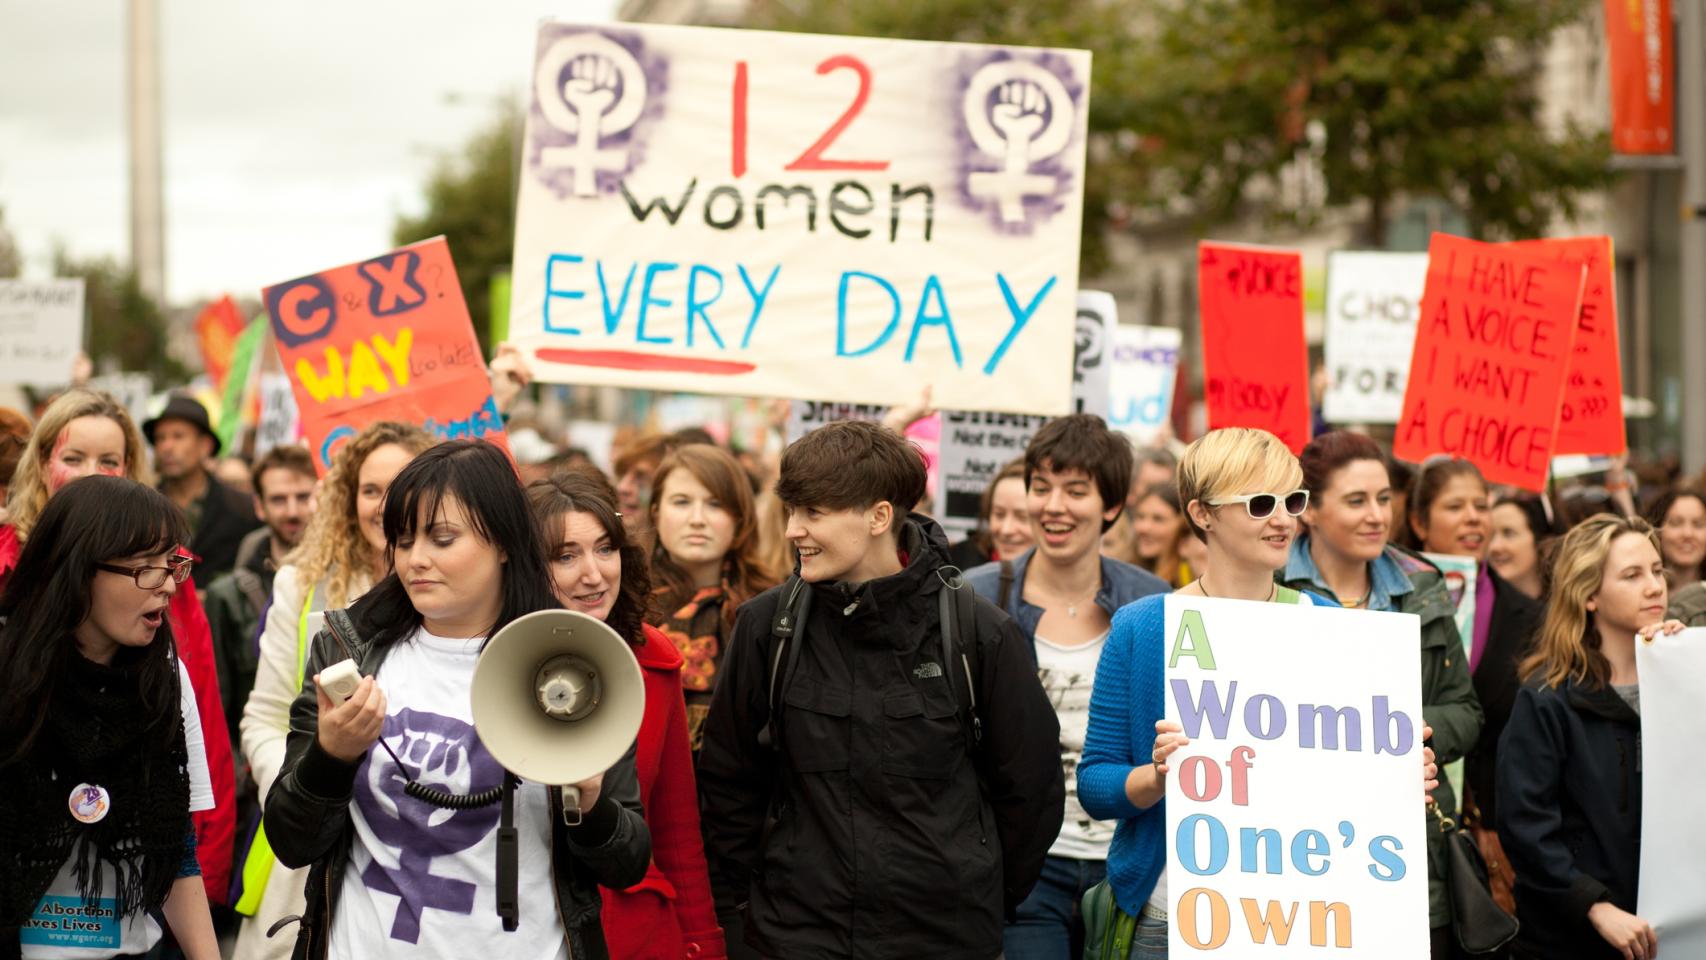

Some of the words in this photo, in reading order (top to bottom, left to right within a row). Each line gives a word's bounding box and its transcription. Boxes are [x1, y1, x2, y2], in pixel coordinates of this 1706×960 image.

[731, 54, 891, 178] 12
[619, 177, 936, 242] women
[1469, 256, 1548, 308] HAVE
[542, 253, 781, 349] EVERY
[836, 270, 1057, 375] DAY
[1429, 298, 1451, 338] A
[295, 328, 413, 404] WAY
[1455, 354, 1538, 408] WANT
[953, 429, 984, 447] Not
[1405, 398, 1428, 448] A
[1440, 407, 1552, 471] CHOICE
[1168, 609, 1217, 671] A
[1169, 678, 1414, 756] Womb
[1178, 745, 1256, 807] of
[1175, 813, 1407, 882] One's
[40, 902, 113, 917] Abortion
[62, 918, 101, 931] Lives
[1176, 887, 1353, 951] Own
